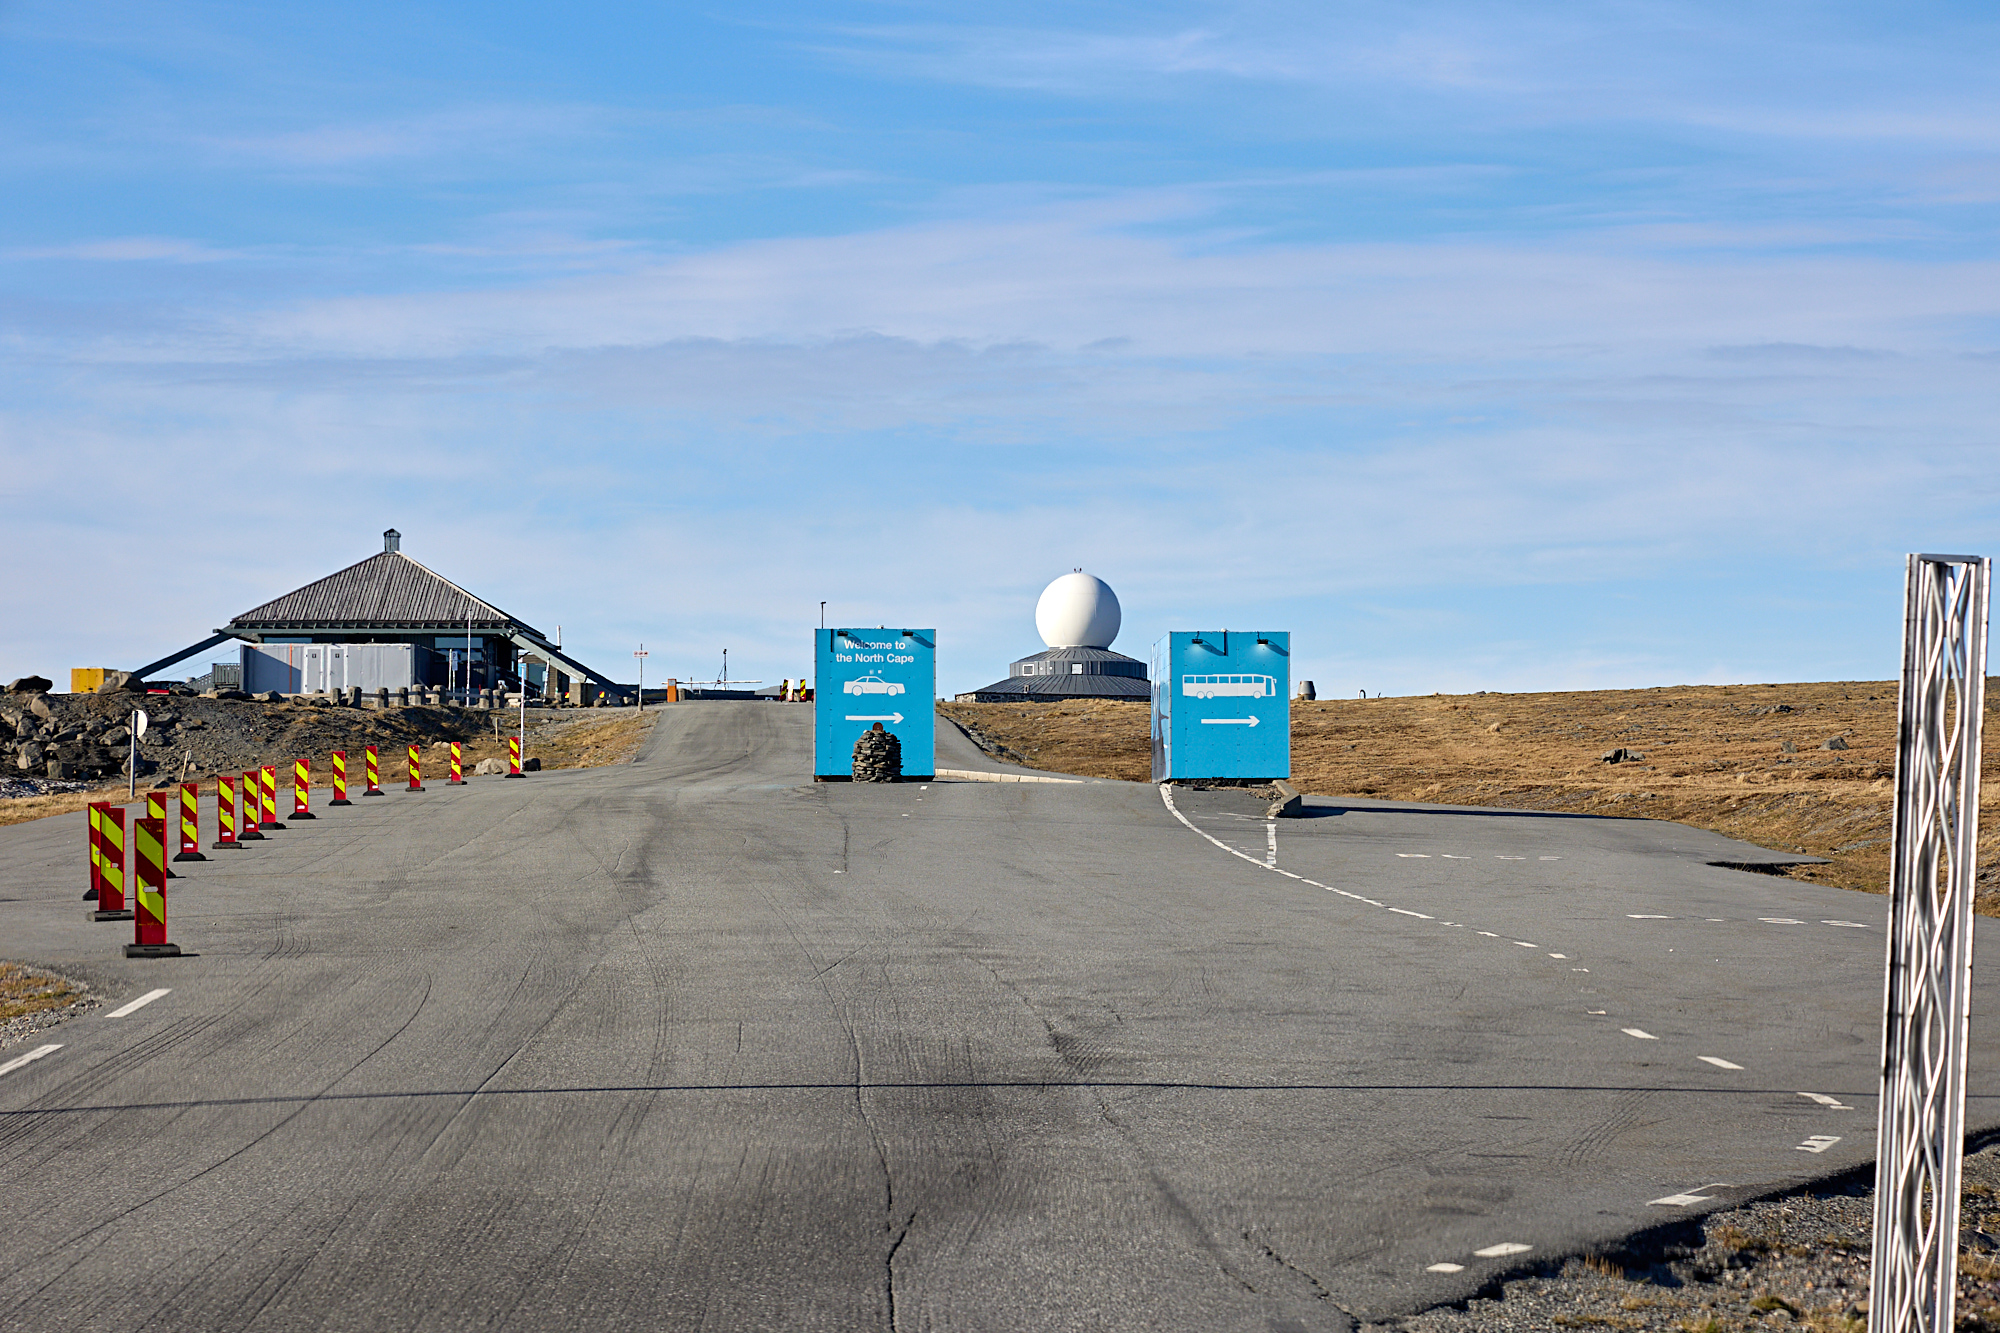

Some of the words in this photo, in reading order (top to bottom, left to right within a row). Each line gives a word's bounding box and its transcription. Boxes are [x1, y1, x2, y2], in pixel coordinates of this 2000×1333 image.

[844, 640, 892, 650] Welcome
[895, 641, 906, 650] to
[836, 654, 852, 662] the
[855, 654, 884, 662] North
[886, 654, 914, 664] Cape
